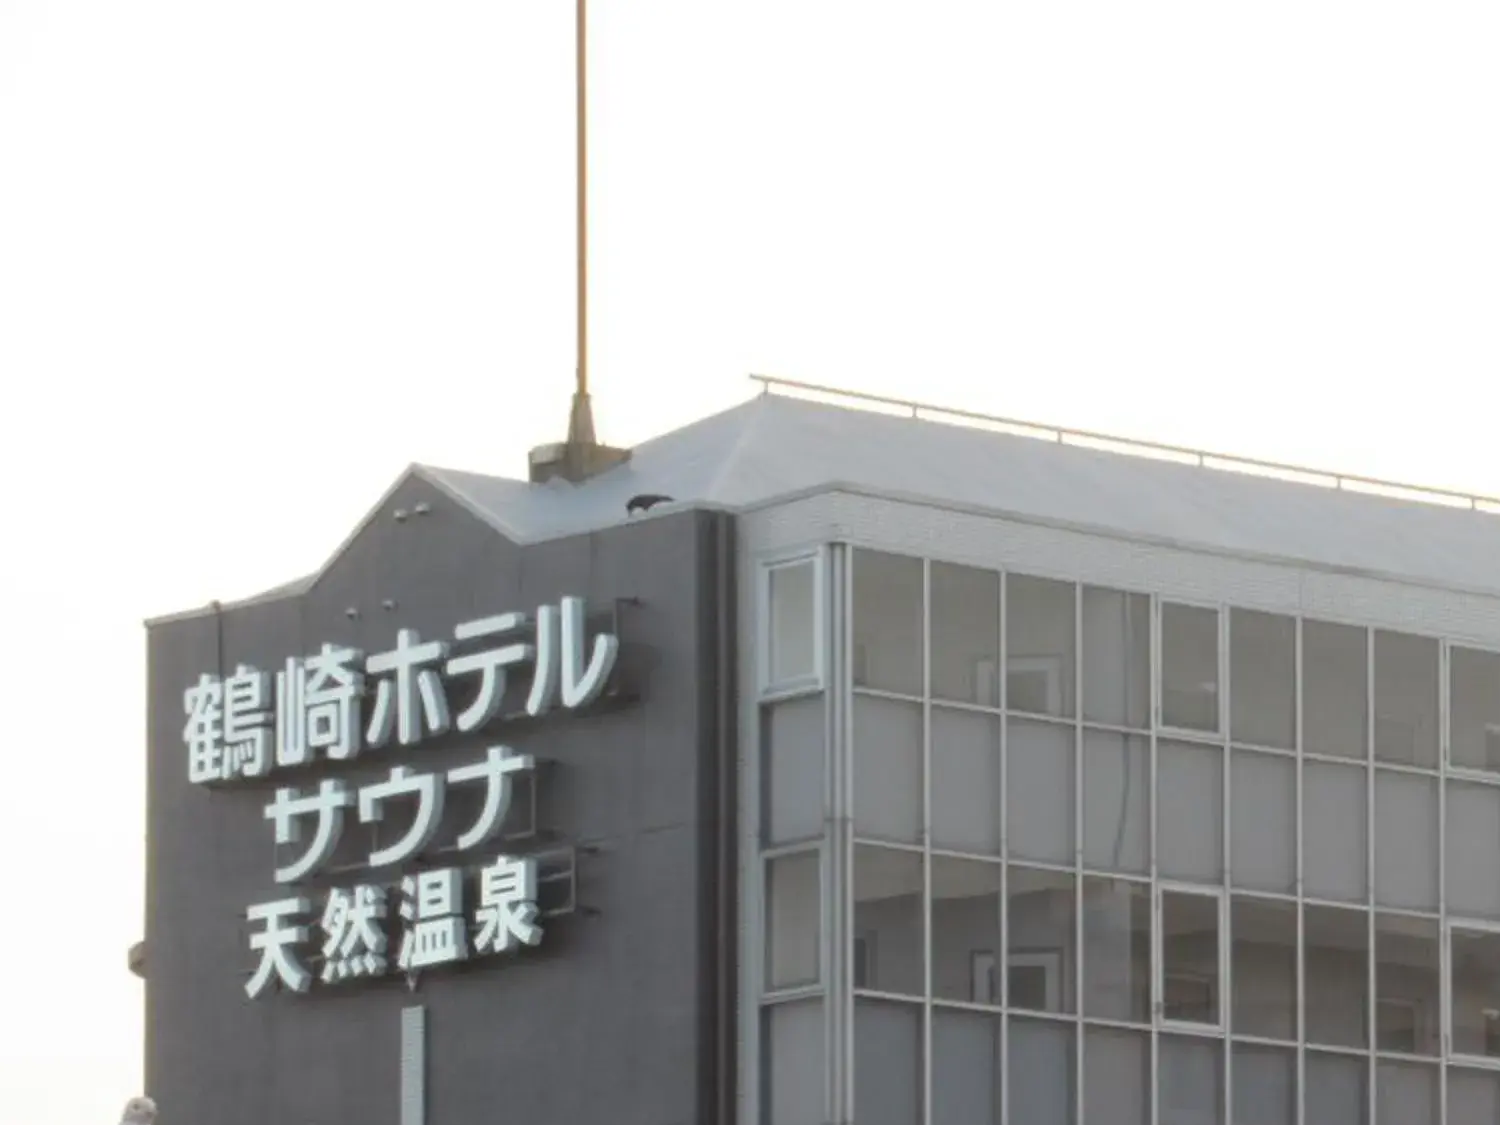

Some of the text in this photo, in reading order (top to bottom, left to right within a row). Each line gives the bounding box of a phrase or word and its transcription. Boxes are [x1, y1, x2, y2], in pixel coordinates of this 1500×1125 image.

[183, 595, 618, 784] 鶴崎ホテル
[263, 746, 536, 884] サウナ
[244, 855, 543, 999] 天然温泉
